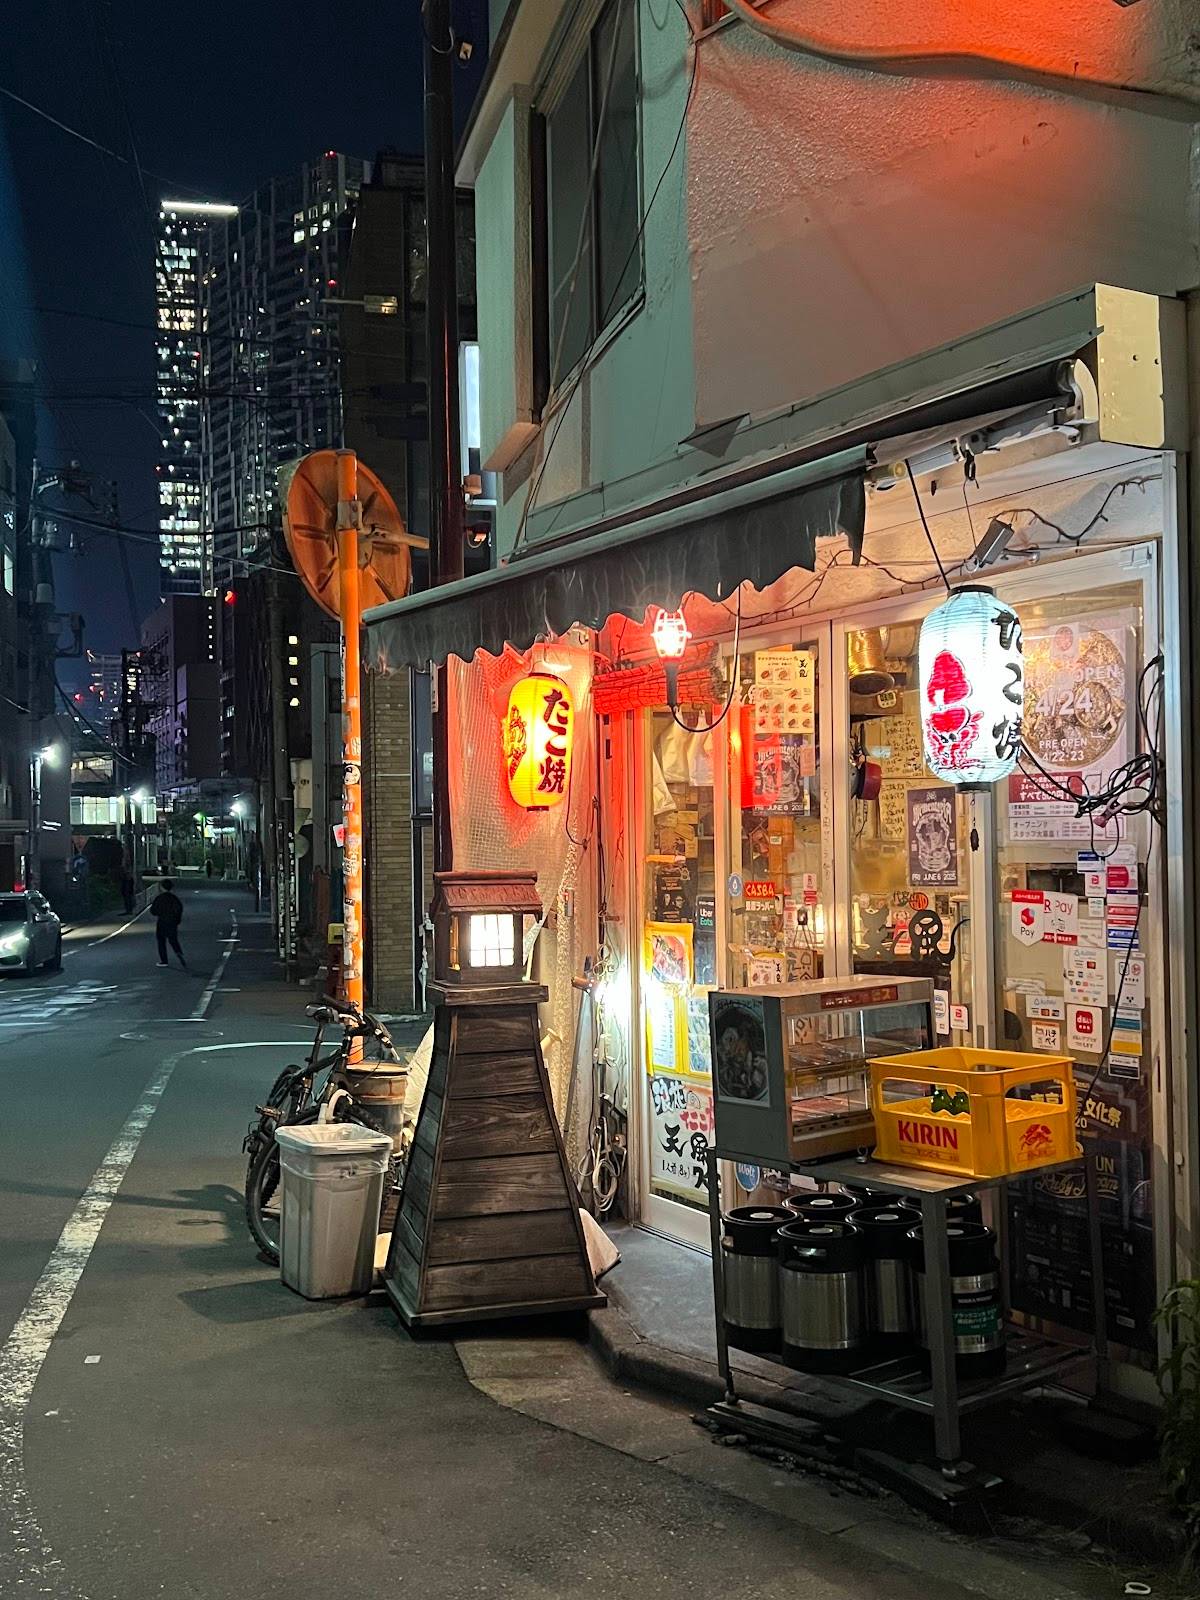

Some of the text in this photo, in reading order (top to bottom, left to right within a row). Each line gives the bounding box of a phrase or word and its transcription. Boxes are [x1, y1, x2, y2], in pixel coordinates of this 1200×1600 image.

[991, 607, 1023, 760] たこ焼
[1035, 687, 1094, 717] 4/24
[537, 688, 571, 794] たこ焼
[1039, 737, 1088, 750] PRE OPEN
[923, 873, 938, 881] JUNE
[700, 908, 713, 917] Uber
[700, 917, 713, 926] Eats
[1020, 926, 1035, 939] Pay
[1083, 1098, 1121, 1128] 文化祭
[897, 1119, 959, 1150] KIRIN
